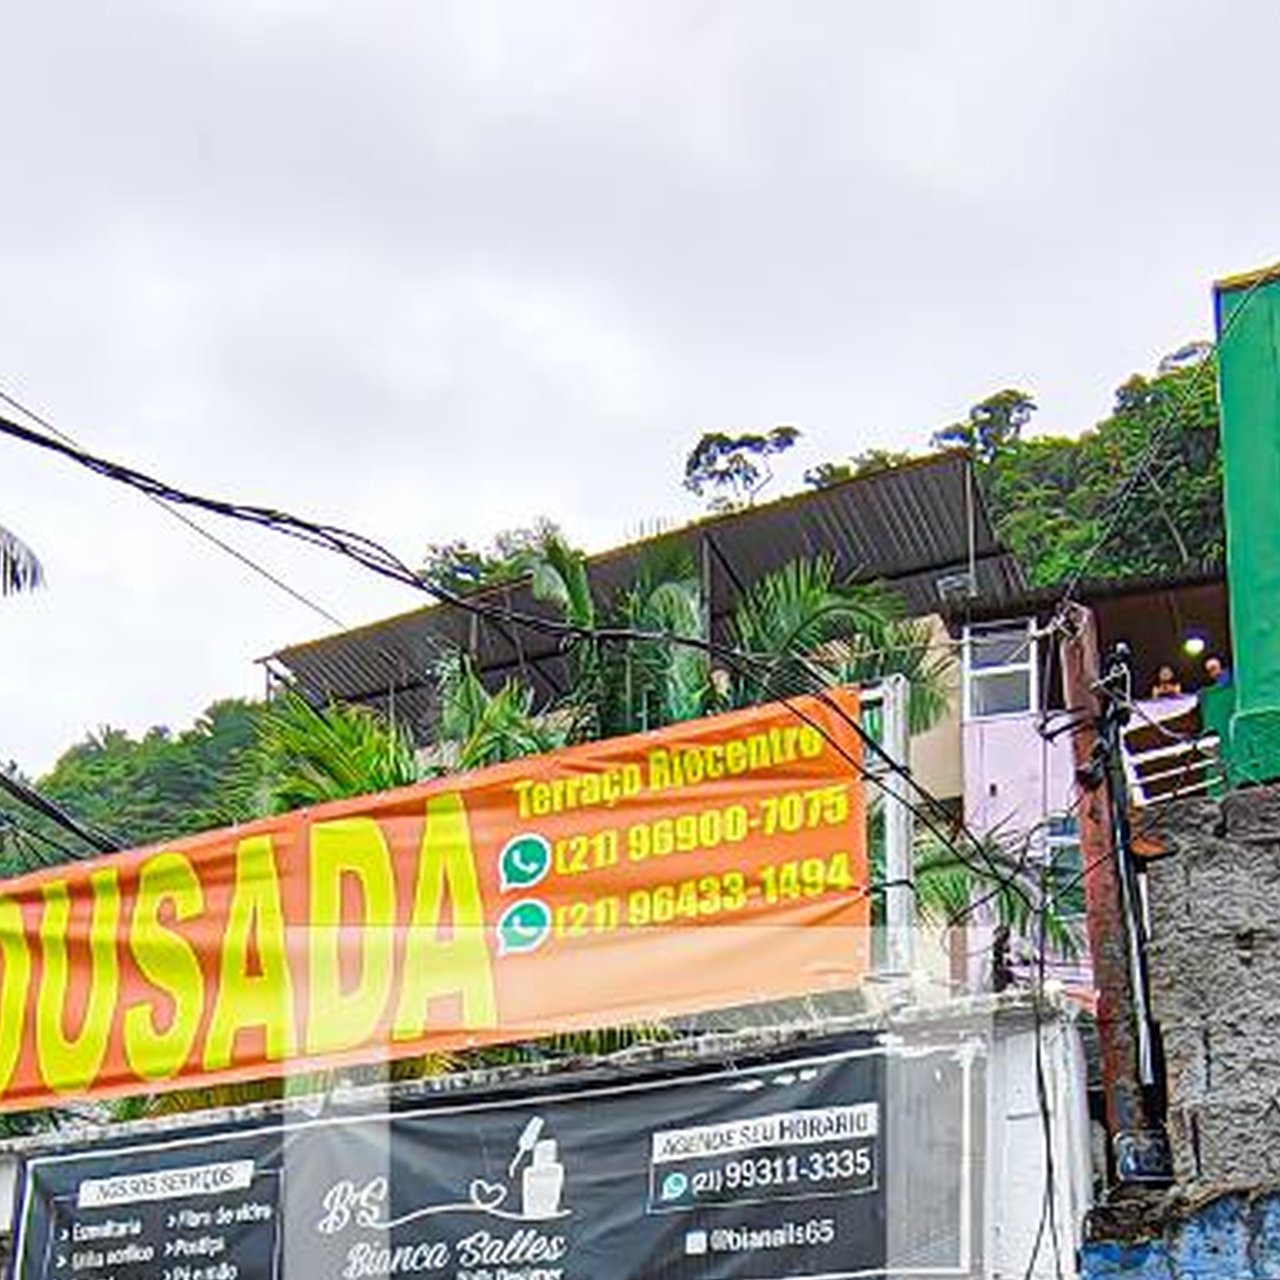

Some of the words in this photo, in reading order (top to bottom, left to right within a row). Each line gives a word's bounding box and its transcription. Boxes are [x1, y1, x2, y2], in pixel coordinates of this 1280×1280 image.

[514, 762, 642, 818] Terraço
[649, 722, 824, 793] Riocentro
[553, 833, 618, 876] (21)
[628, 784, 850, 862] 96900-7075
[553, 901, 618, 939] (21)
[628, 852, 854, 926] 96433-1494
[740, 1124, 775, 1145] SEU
[725, 1147, 870, 1189] 99311-3335
[342, 1240, 451, 1280] Bianca
[455, 1229, 569, 1267] Salles
[710, 1219, 835, 1251] @bianails65
